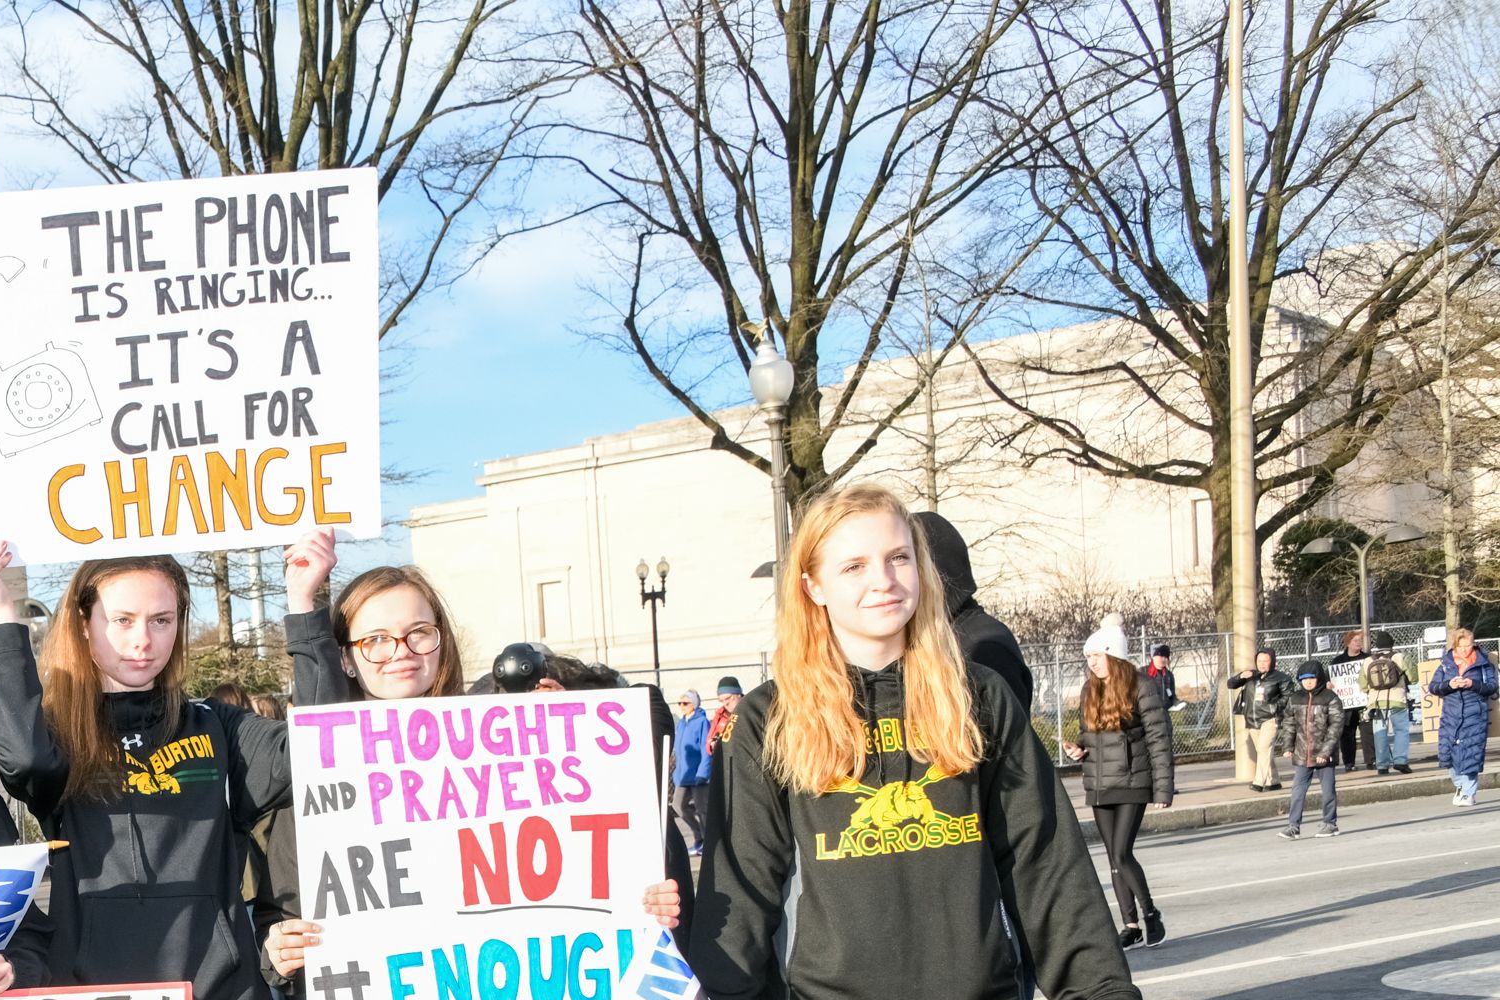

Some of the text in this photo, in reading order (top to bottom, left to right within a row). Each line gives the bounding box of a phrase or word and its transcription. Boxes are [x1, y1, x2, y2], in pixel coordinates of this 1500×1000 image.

[41, 184, 351, 277] THE PHONE
[72, 267, 333, 323] IS RINGING...
[115, 320, 321, 389] IT'S A
[111, 387, 318, 455] CALL FOR
[48, 441, 352, 545] CHANGE
[1330, 662, 1361, 678] MARC
[149, 734, 215, 775] BURTON
[293, 701, 631, 769] THOUGHTS
[302, 755, 593, 825] AND PRAYERS
[313, 812, 630, 920] ARE NOT
[816, 813, 982, 861] LACROSSE
